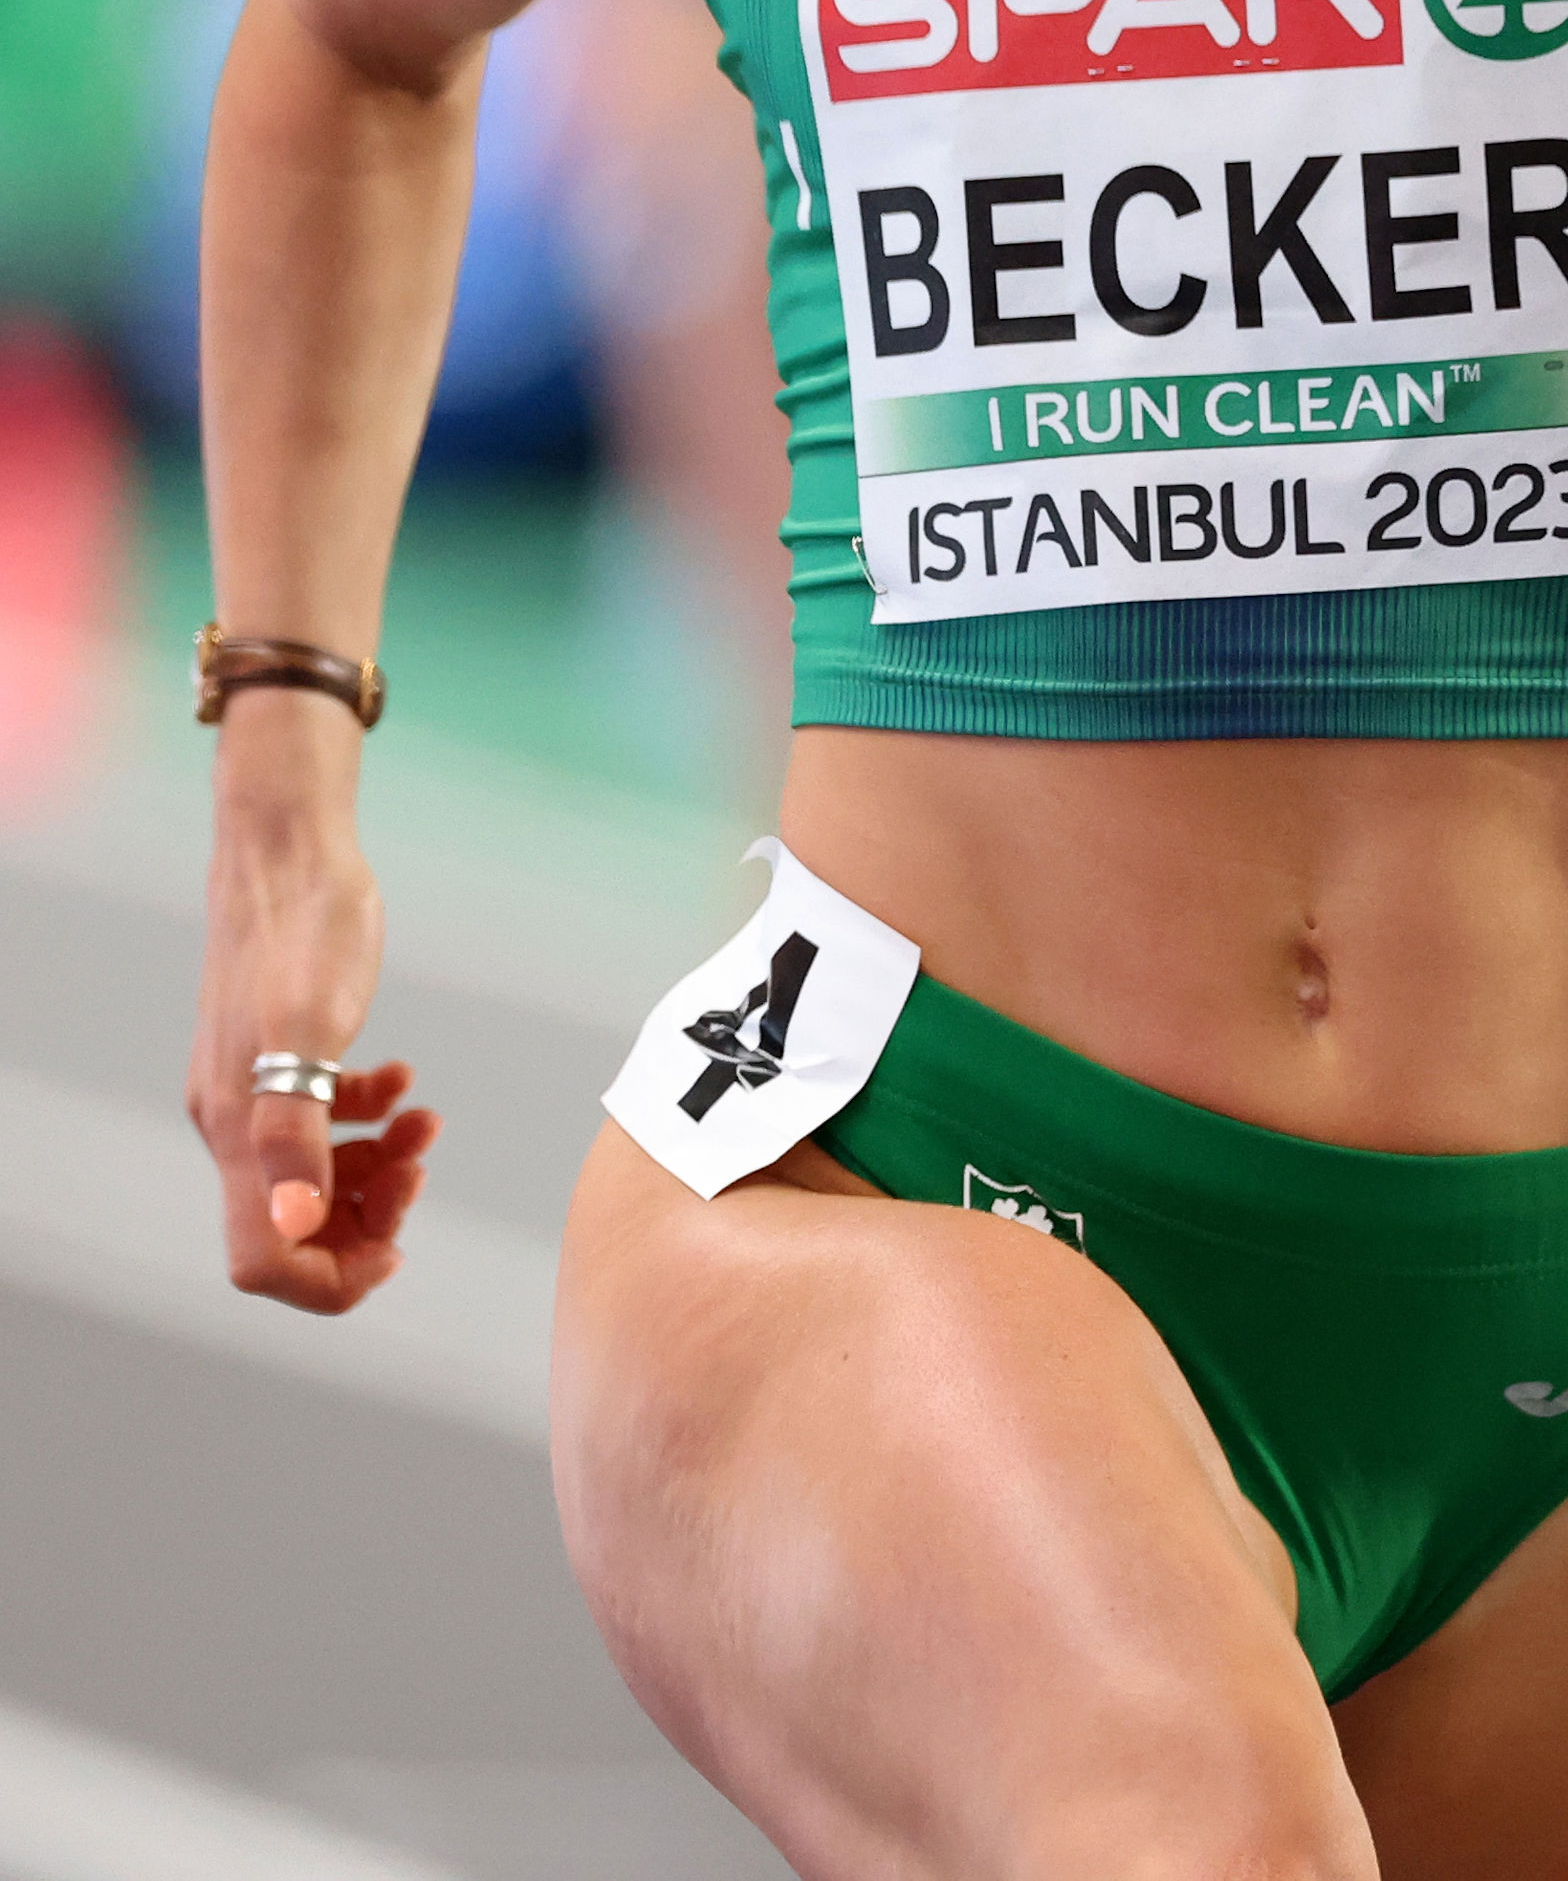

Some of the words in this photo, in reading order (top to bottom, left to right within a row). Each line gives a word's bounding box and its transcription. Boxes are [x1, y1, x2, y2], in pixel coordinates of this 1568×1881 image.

[988, 397, 1004, 452] I
[1025, 383, 1180, 449] RUN
[906, 477, 1345, 585] ISTANBUL
